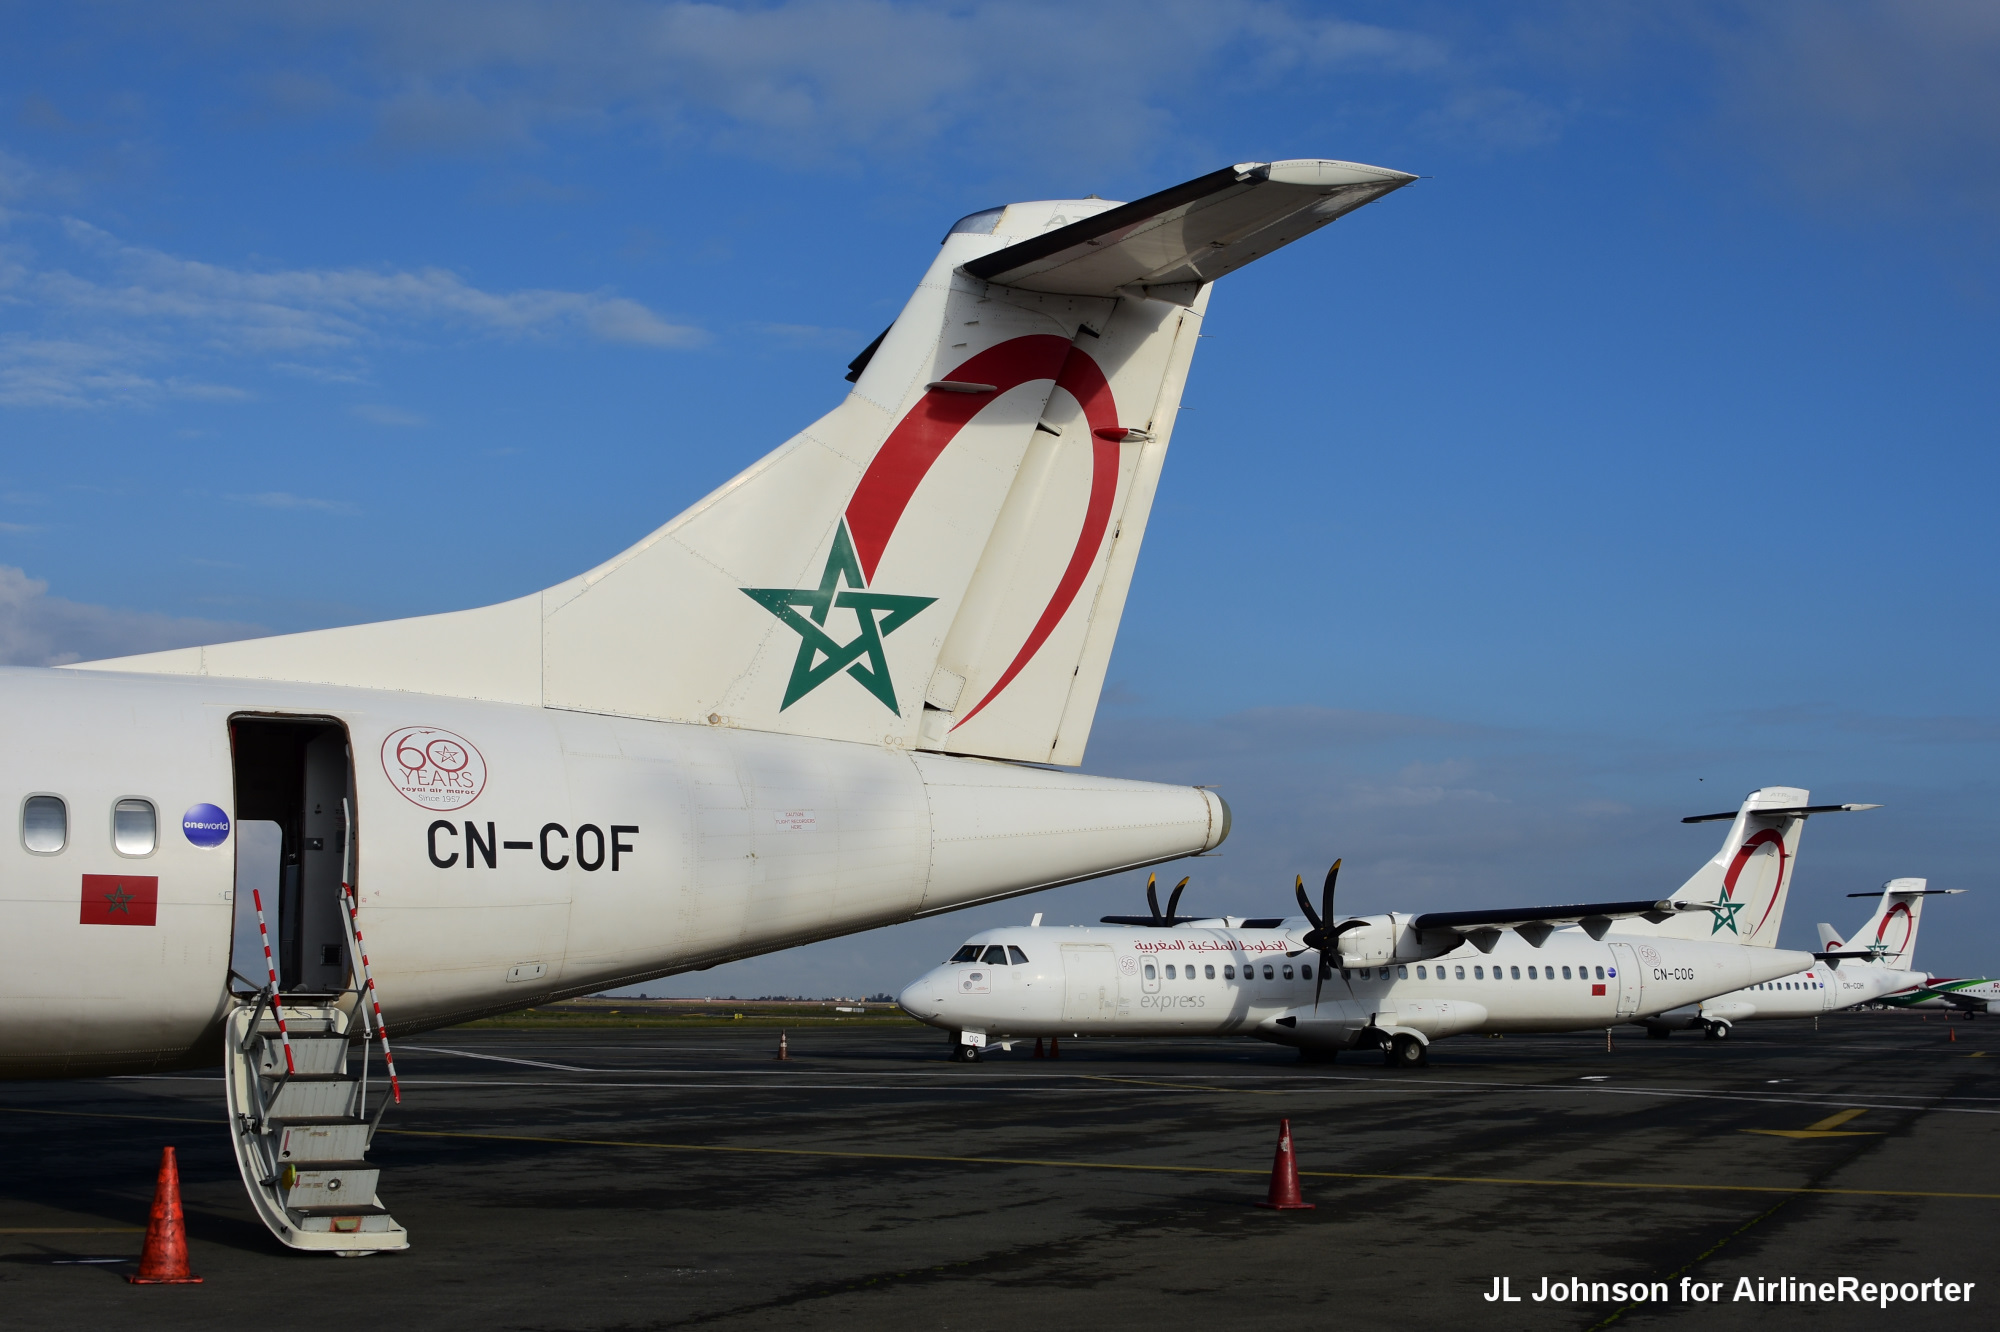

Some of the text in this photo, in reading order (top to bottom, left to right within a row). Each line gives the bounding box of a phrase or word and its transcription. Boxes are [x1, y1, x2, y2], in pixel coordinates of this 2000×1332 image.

[396, 732, 469, 772] 60
[399, 768, 474, 788] YEARS
[418, 794, 461, 803] Since 1957
[184, 821, 229, 831] oneworld
[427, 820, 640, 872] CN-COF
[1134, 939, 1288, 954] الخطوط الملكية المغربية
[1653, 967, 1694, 981] CN-COG
[1140, 995, 1206, 1013] express
